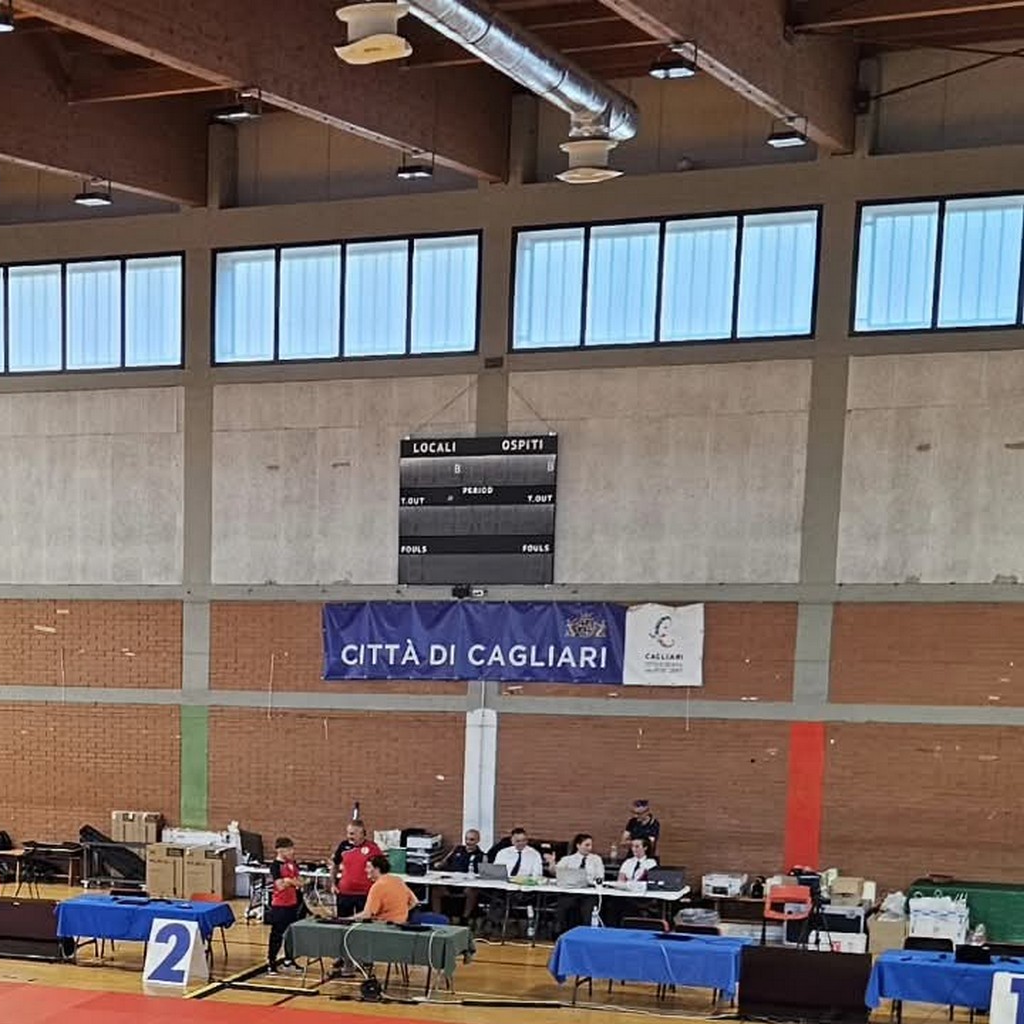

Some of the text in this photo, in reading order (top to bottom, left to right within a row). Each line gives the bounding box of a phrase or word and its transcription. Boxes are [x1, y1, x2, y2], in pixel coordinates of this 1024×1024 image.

[413, 442, 457, 454] LOCALI
[501, 438, 544, 451] OSPITI
[462, 486, 494, 495] PERIOD
[401, 496, 425, 506] T.OUT
[527, 494, 553, 503] T.OUT
[400, 545, 428, 554] FOULS
[522, 544, 550, 553] FOULS
[340, 638, 608, 669] CITTÀ DI CAGLIARI
[147, 922, 192, 984] 2
